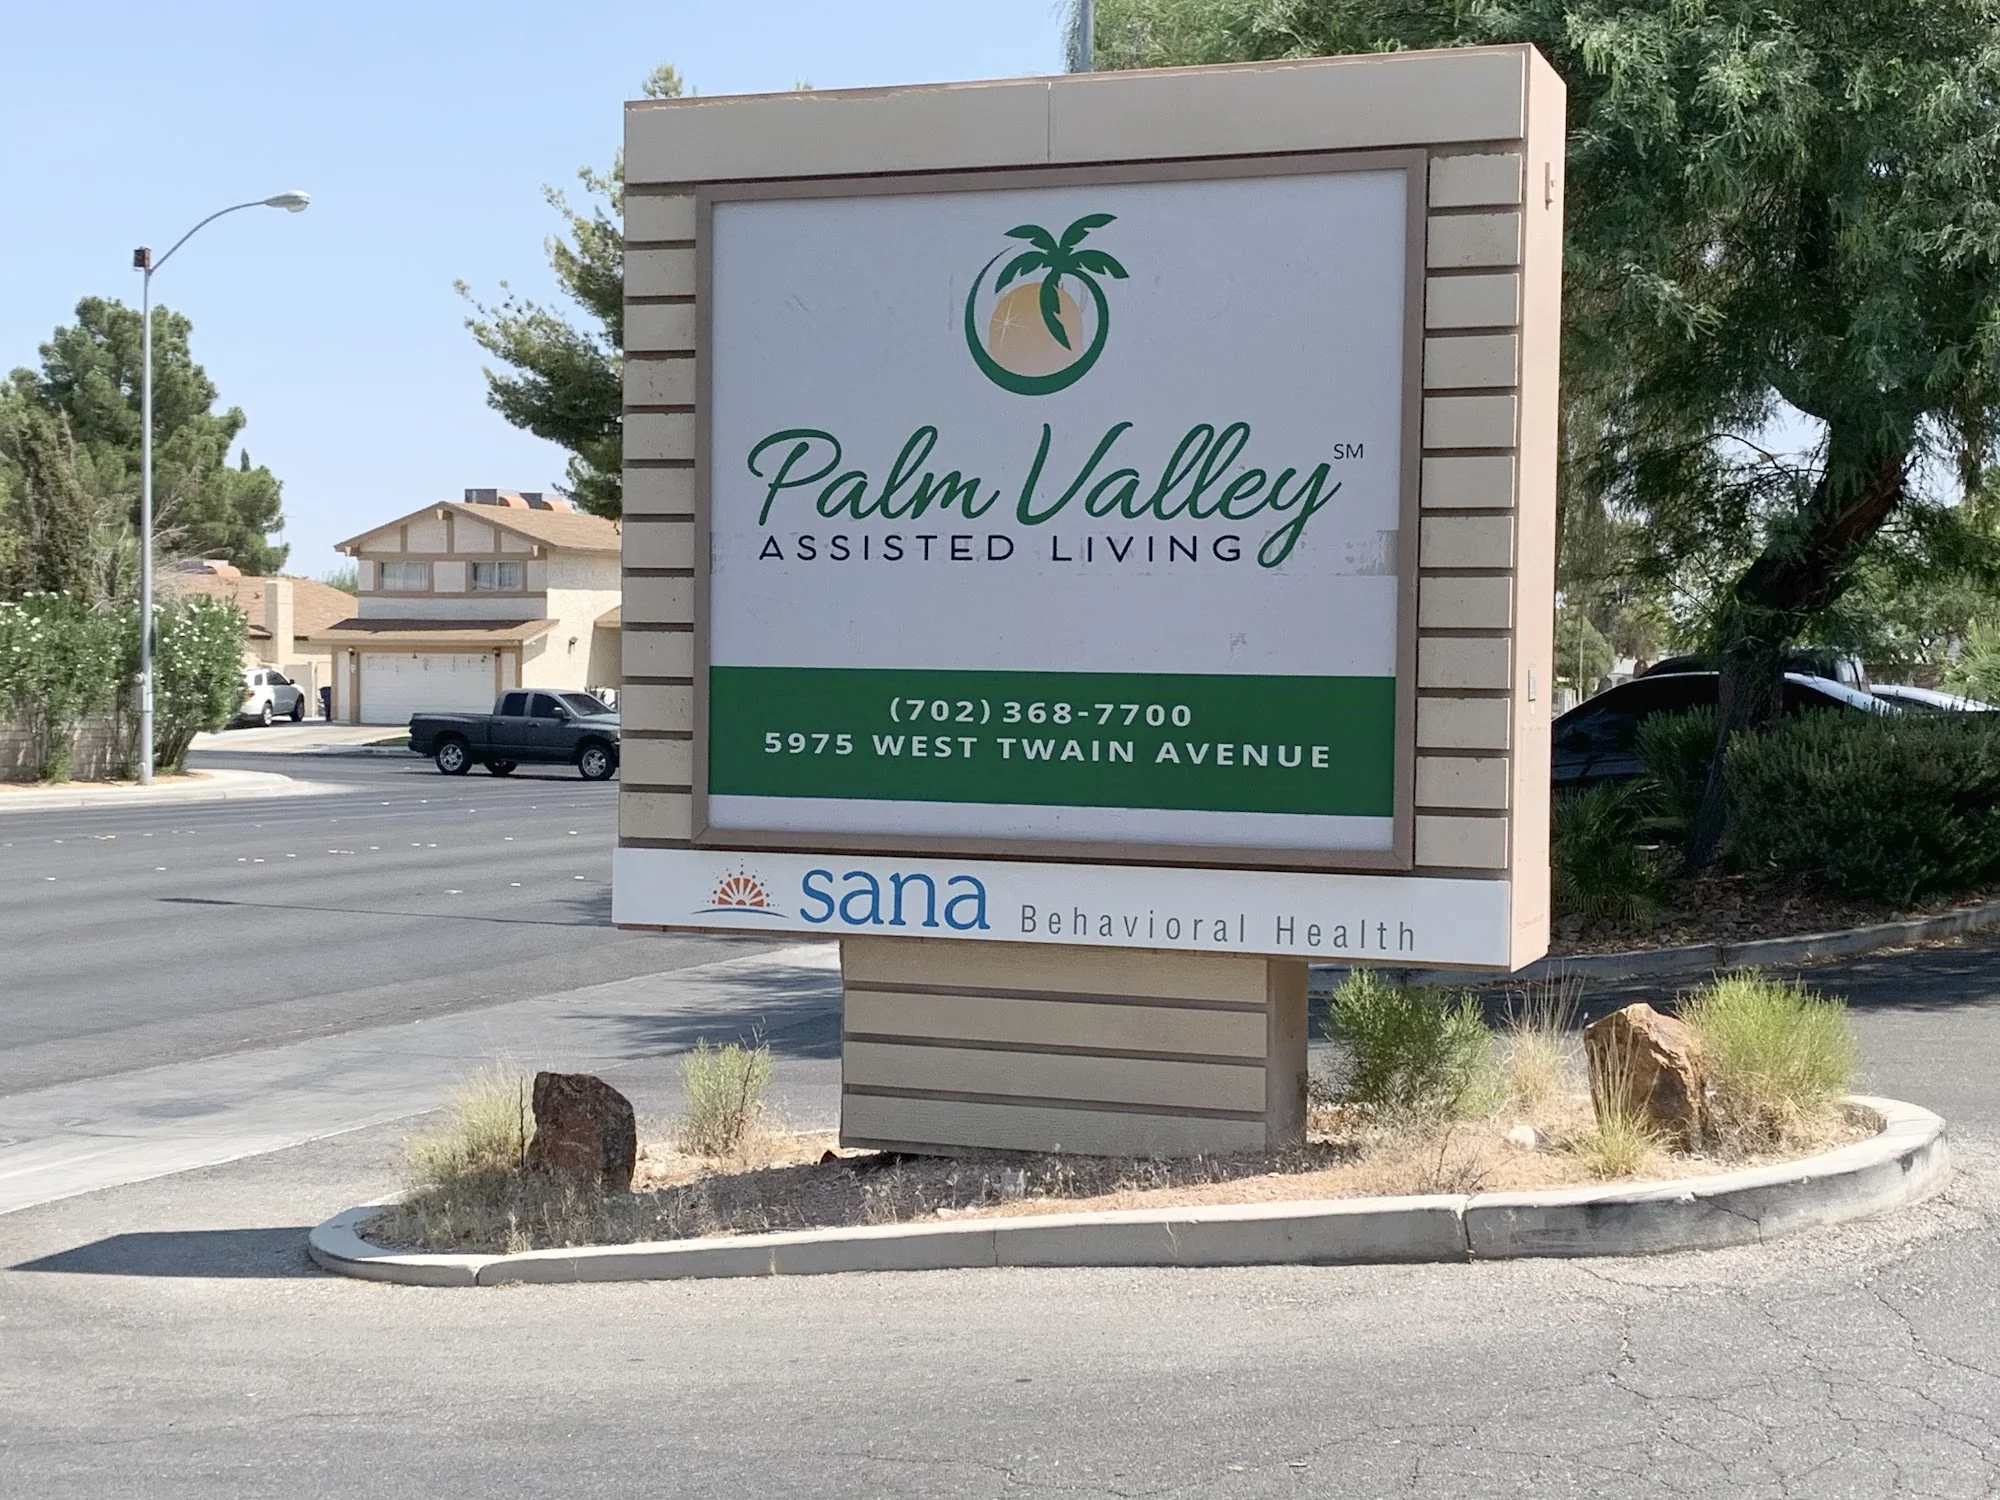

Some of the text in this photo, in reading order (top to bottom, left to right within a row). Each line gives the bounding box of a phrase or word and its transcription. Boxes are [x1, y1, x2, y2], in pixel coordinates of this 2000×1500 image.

[748, 421, 1364, 568] Palm Valley SM
[759, 535, 1240, 562] ASSISTED LIVING
[889, 697, 1192, 727] (702) 368-7700
[764, 732, 1330, 768] 5975 WEST TWAIN AVENUE
[800, 868, 1415, 951] sana Behavioral Health
